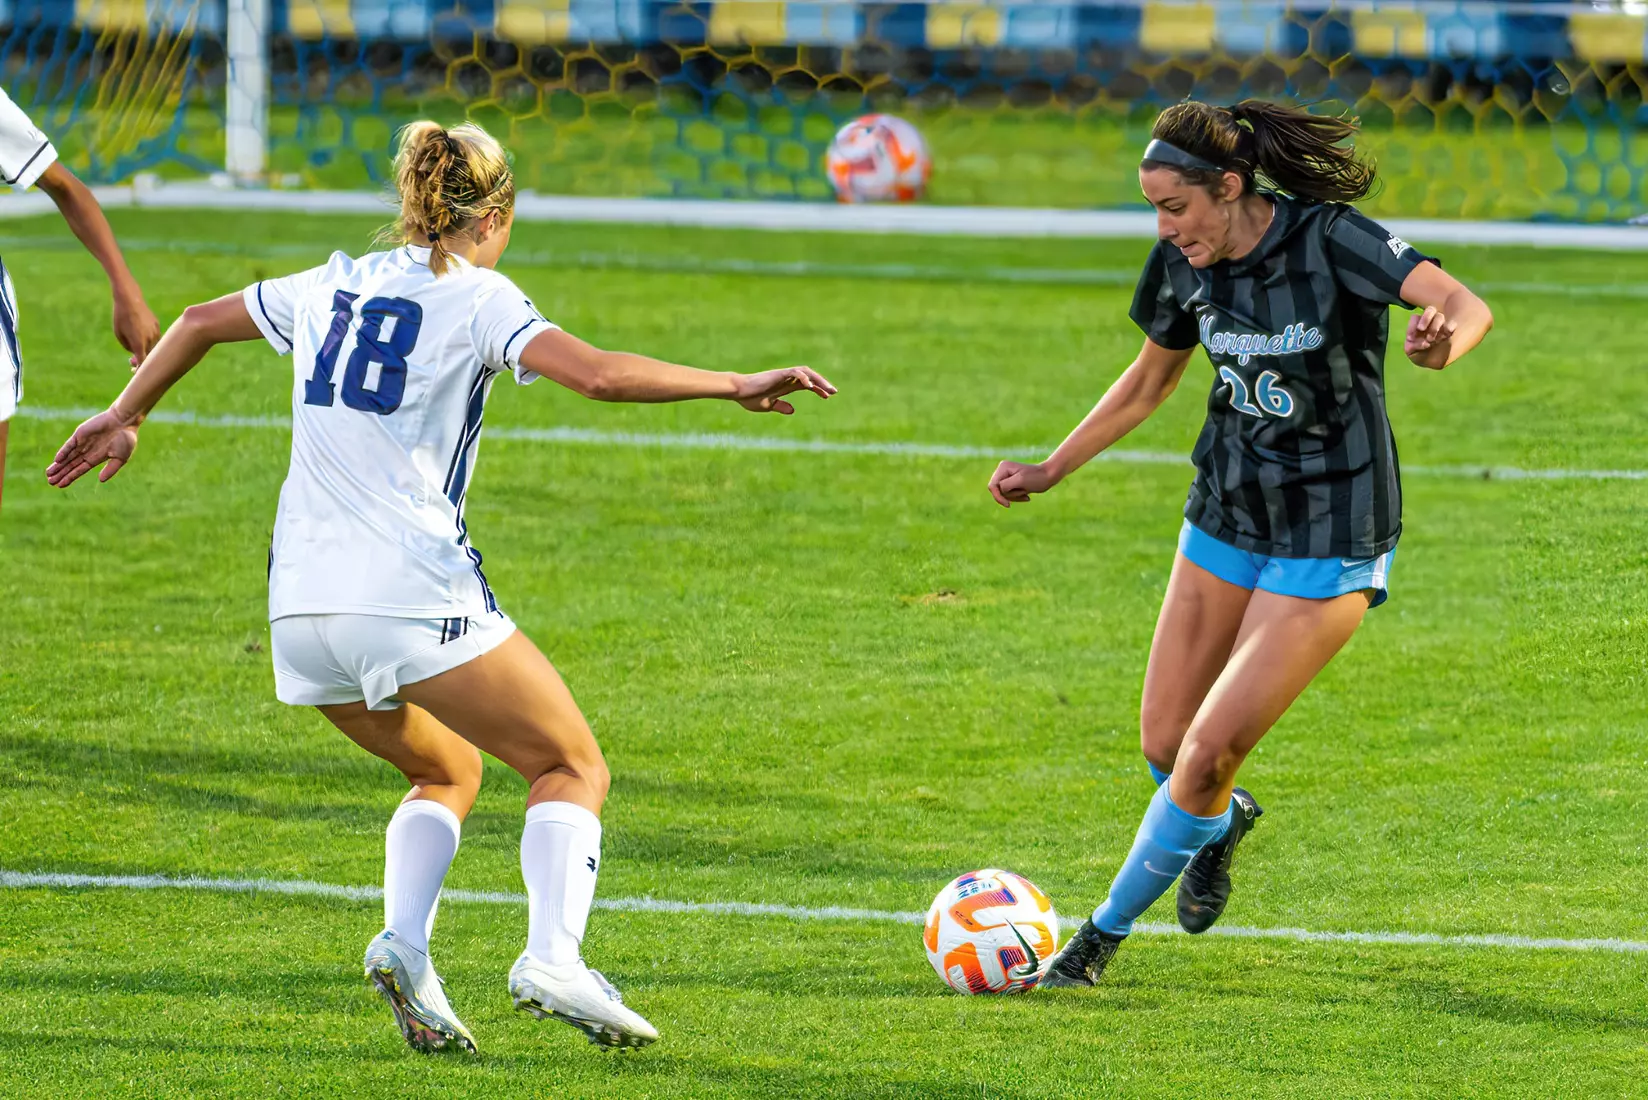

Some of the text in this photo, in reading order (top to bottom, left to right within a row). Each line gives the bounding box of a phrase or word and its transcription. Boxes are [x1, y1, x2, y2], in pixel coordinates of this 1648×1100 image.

[304, 289, 423, 415] 18
[1199, 314, 1323, 366] Marquette
[1219, 365, 1294, 417] 26
